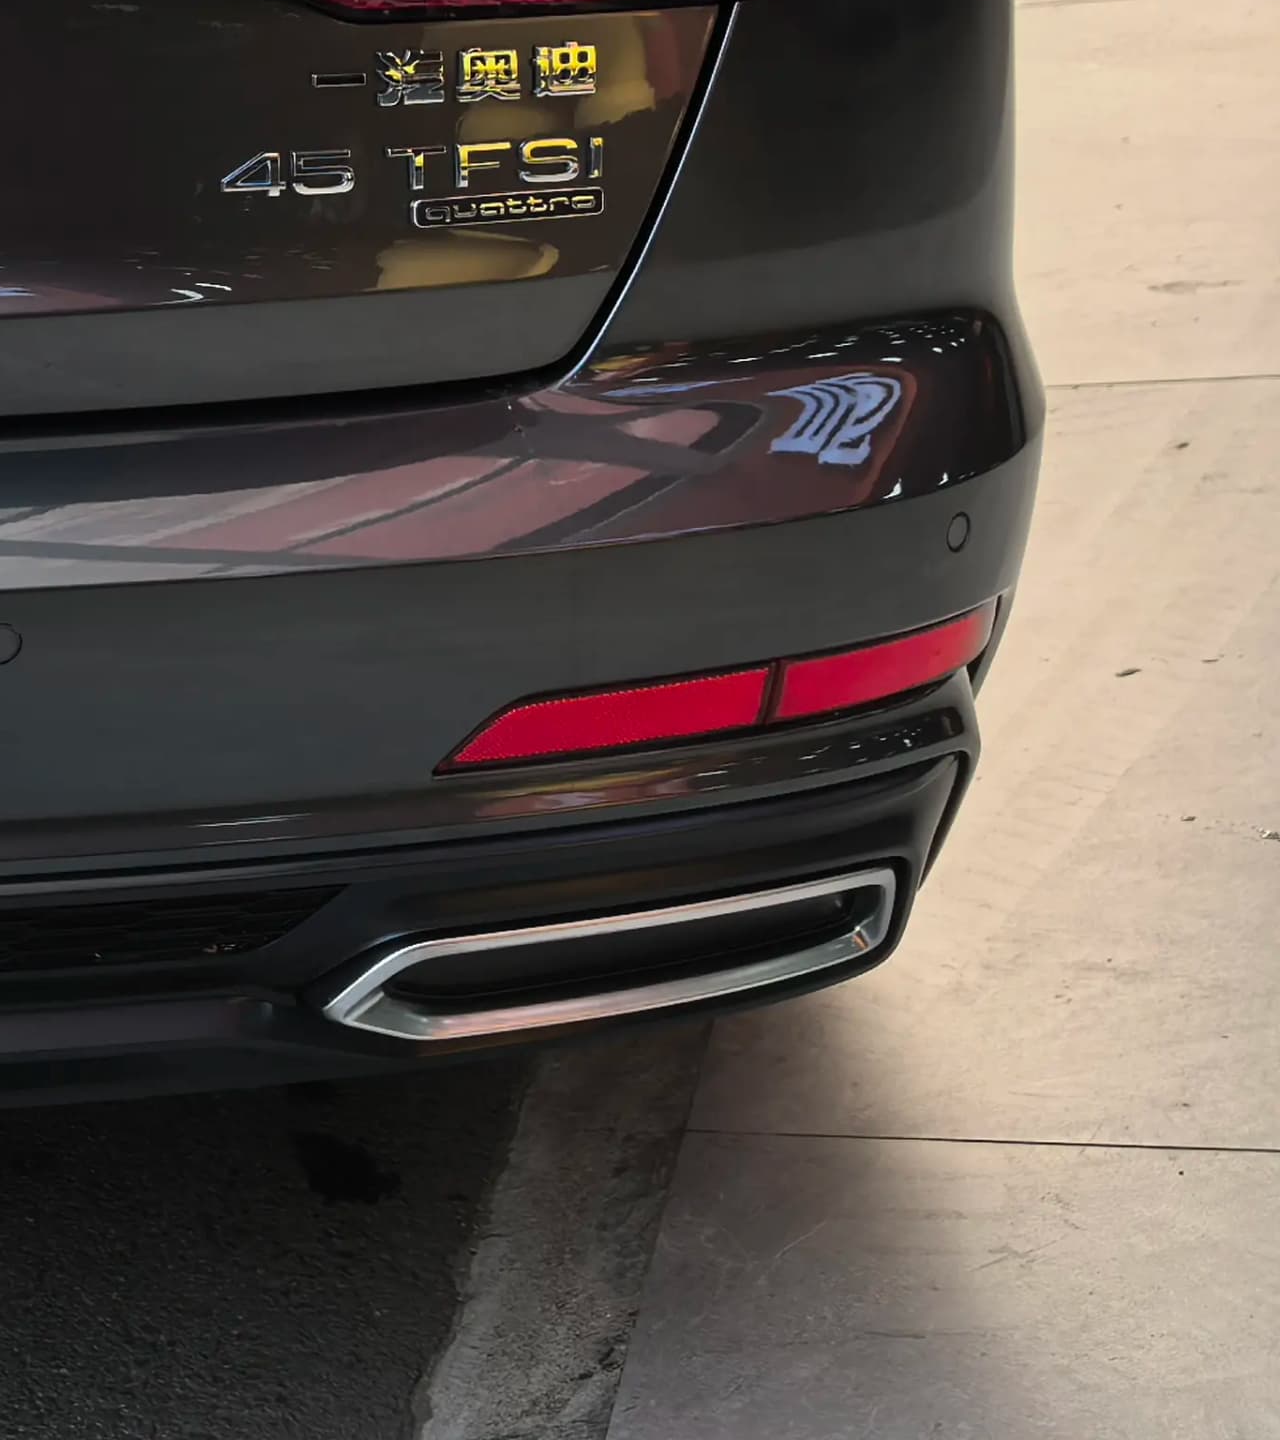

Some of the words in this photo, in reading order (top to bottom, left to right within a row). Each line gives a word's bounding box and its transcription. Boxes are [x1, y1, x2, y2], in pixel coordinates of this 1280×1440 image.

[311, 41, 597, 106] 一汽奥迪
[220, 149, 356, 197] 45
[385, 137, 605, 190] TFSI
[423, 192, 597, 224] quattro
